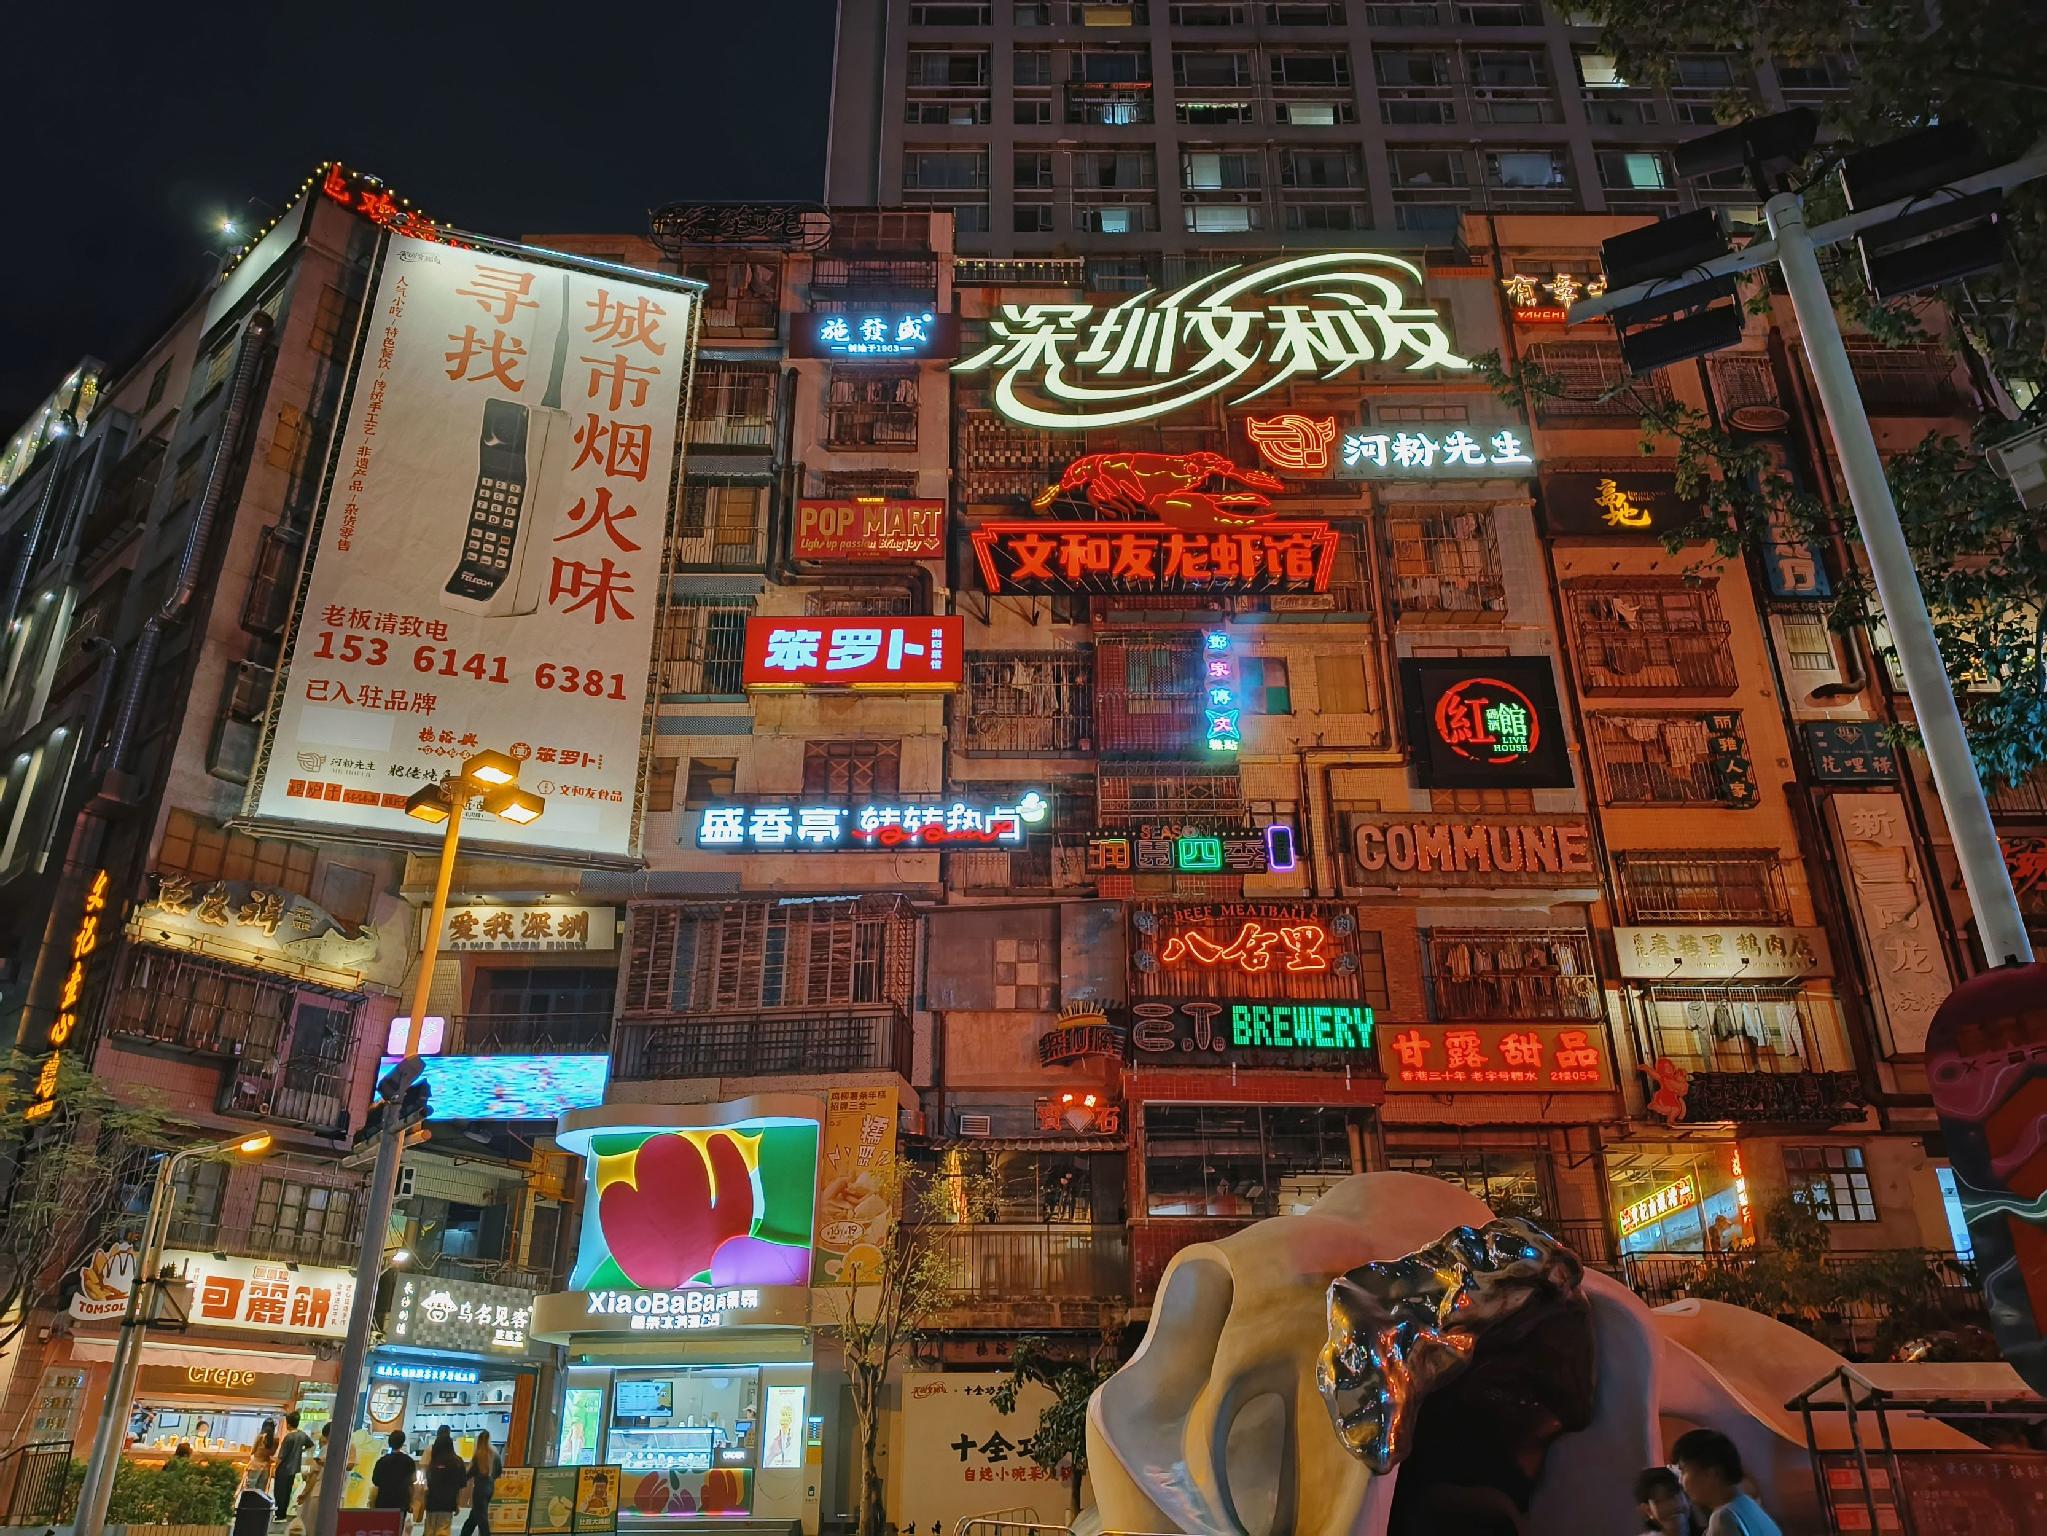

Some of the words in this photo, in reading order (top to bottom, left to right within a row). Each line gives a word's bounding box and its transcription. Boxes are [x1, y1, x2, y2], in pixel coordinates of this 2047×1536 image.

[444, 264, 540, 392] 寻找
[549, 288, 667, 625] 城市烟火味
[1343, 431, 1533, 467] 河粉先生
[800, 508, 854, 536] POP
[863, 508, 942, 536] MART
[1007, 533, 1317, 581] 文和友龙虾馆
[321, 604, 448, 641] 老板请致电
[313, 631, 389, 666] 153
[413, 645, 510, 684] 6141
[534, 662, 627, 701] 6381
[764, 629, 924, 671] 笨罗卜
[305, 679, 437, 715] 已入驻品牌
[1493, 744, 1529, 752] HOUSE
[1502, 736, 1527, 744] LIVE
[699, 808, 840, 843] 盛香亭
[1356, 823, 1594, 873] COMMUNE
[1175, 907, 1213, 921] BEEF
[1221, 904, 1318, 922] MEATBALLS
[1232, 1005, 1374, 1048] BREWERY
[1392, 1029, 1599, 1069] 甘露甜品
[588, 1291, 716, 1314] XiaoBaBa
[187, 1365, 255, 1389] Crepe
